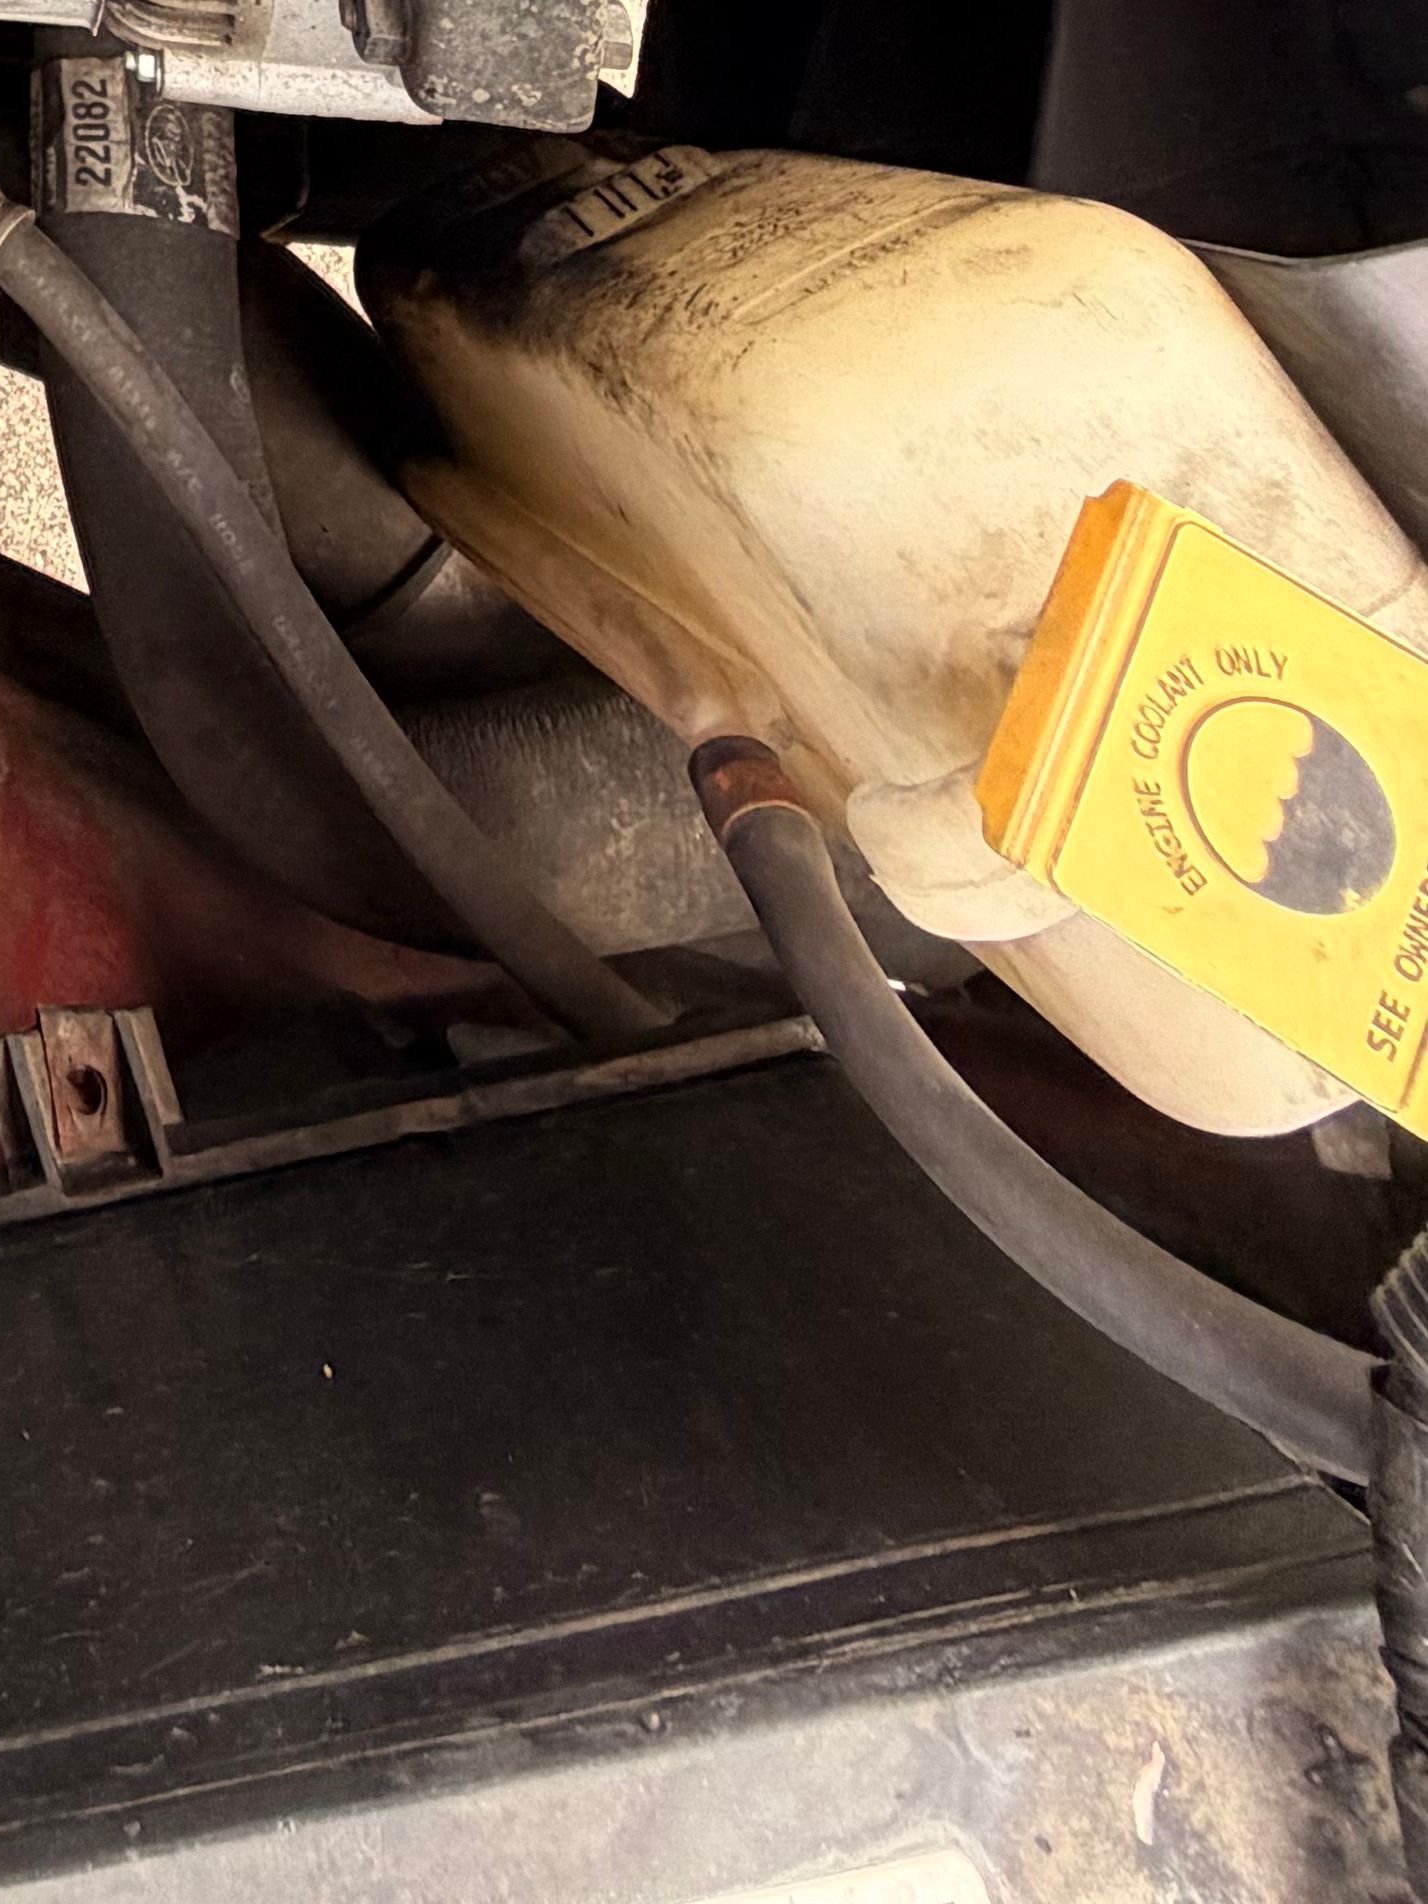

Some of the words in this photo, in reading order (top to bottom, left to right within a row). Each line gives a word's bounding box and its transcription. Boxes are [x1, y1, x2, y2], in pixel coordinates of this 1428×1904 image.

[70, 78, 113, 189] 22082
[1130, 654, 1205, 760] COOLANT
[1214, 646, 1289, 681] ONLY
[1132, 776, 1208, 896] ENGINE
[1366, 989, 1411, 1063] SEE
